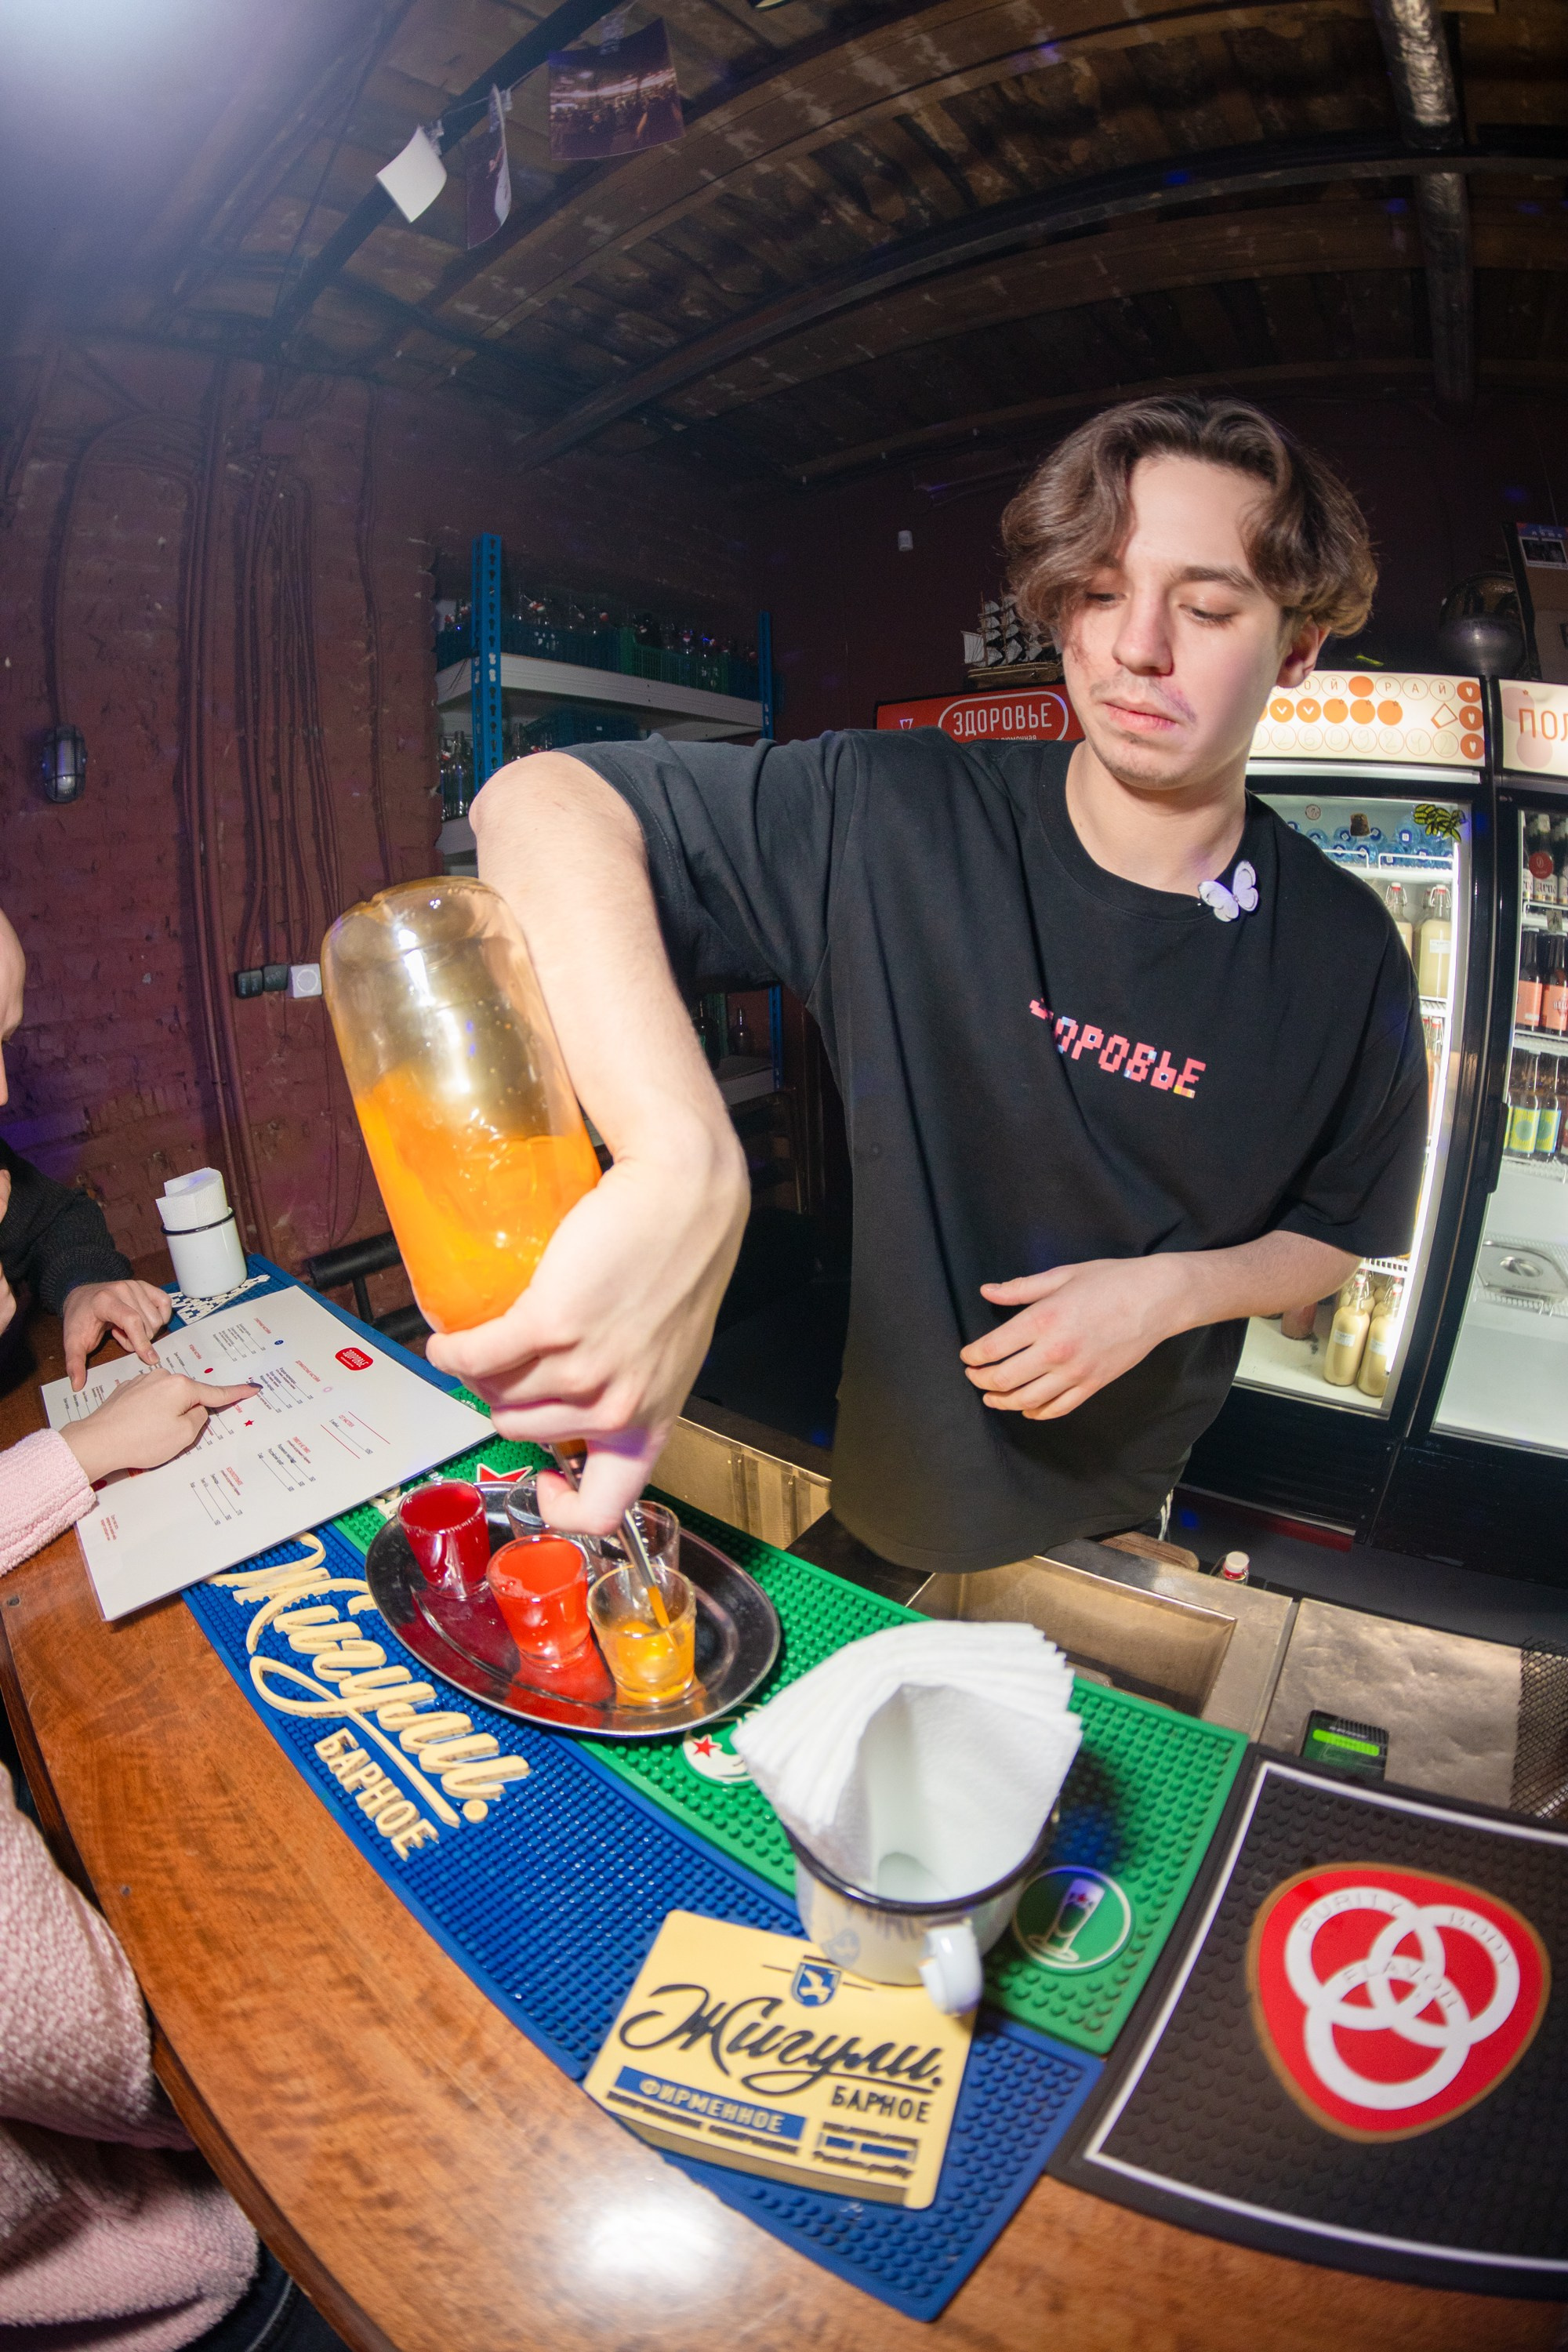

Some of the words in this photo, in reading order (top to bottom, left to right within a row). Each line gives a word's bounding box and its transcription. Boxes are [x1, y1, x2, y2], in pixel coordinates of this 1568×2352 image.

[1385, 683, 1446, 695] РАЙ
[953, 702, 1052, 736] ЗДОРОВЬЕ
[1029, 998, 1207, 1098] ОРОВЬЕ
[343, 1349, 368, 1367] ЗДОРОВЬЕ
[314, 1727, 440, 1862] БАРНОЕ
[1299, 1891, 1403, 1935] PURITY
[1449, 1911, 1513, 1968] BODY
[1341, 1960, 1460, 2010] FLAVOR
[638, 2078, 786, 2134] ФИРМЕННОЕ
[829, 2085, 934, 2124] БАРНОЕ
